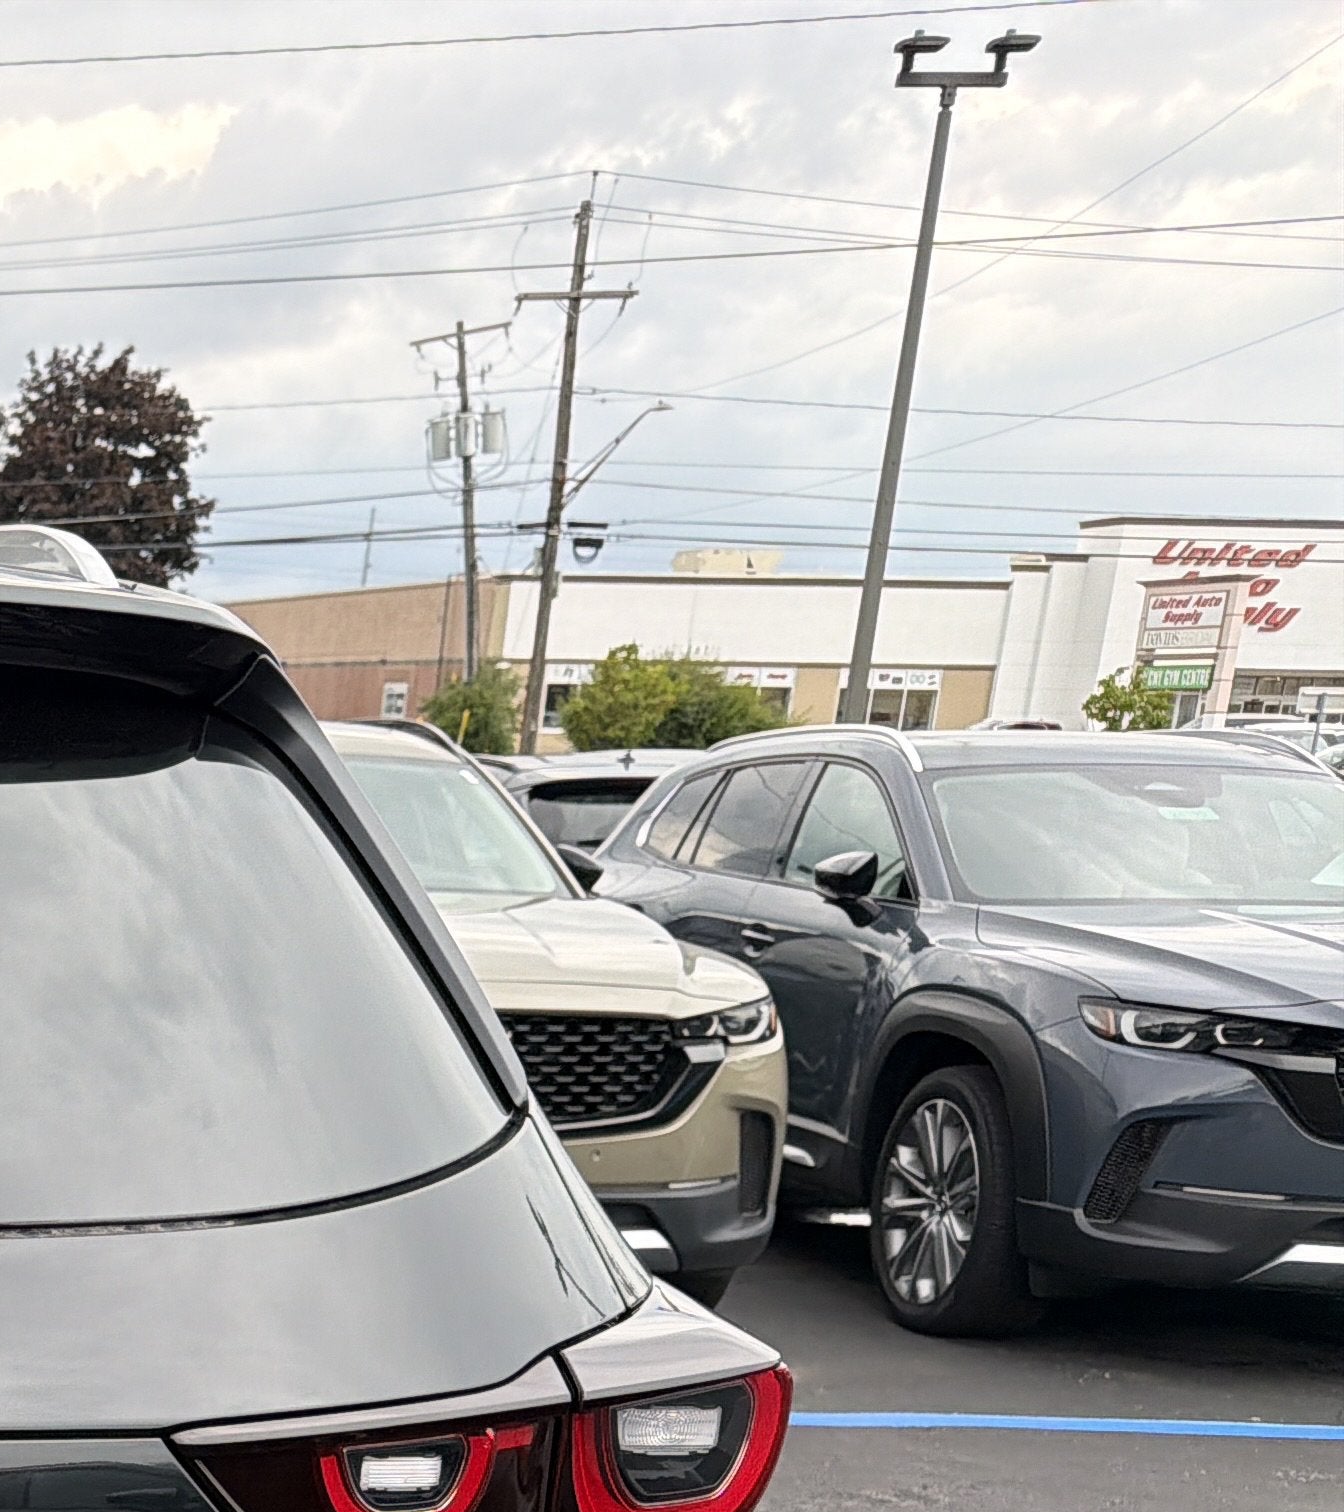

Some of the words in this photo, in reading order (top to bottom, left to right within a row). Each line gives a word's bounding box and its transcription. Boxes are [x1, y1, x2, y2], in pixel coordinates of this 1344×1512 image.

[1152, 540, 1317, 569] United
[1152, 596, 1192, 610] United
[1192, 595, 1223, 609] Auto
[1162, 610, 1203, 626] Supply
